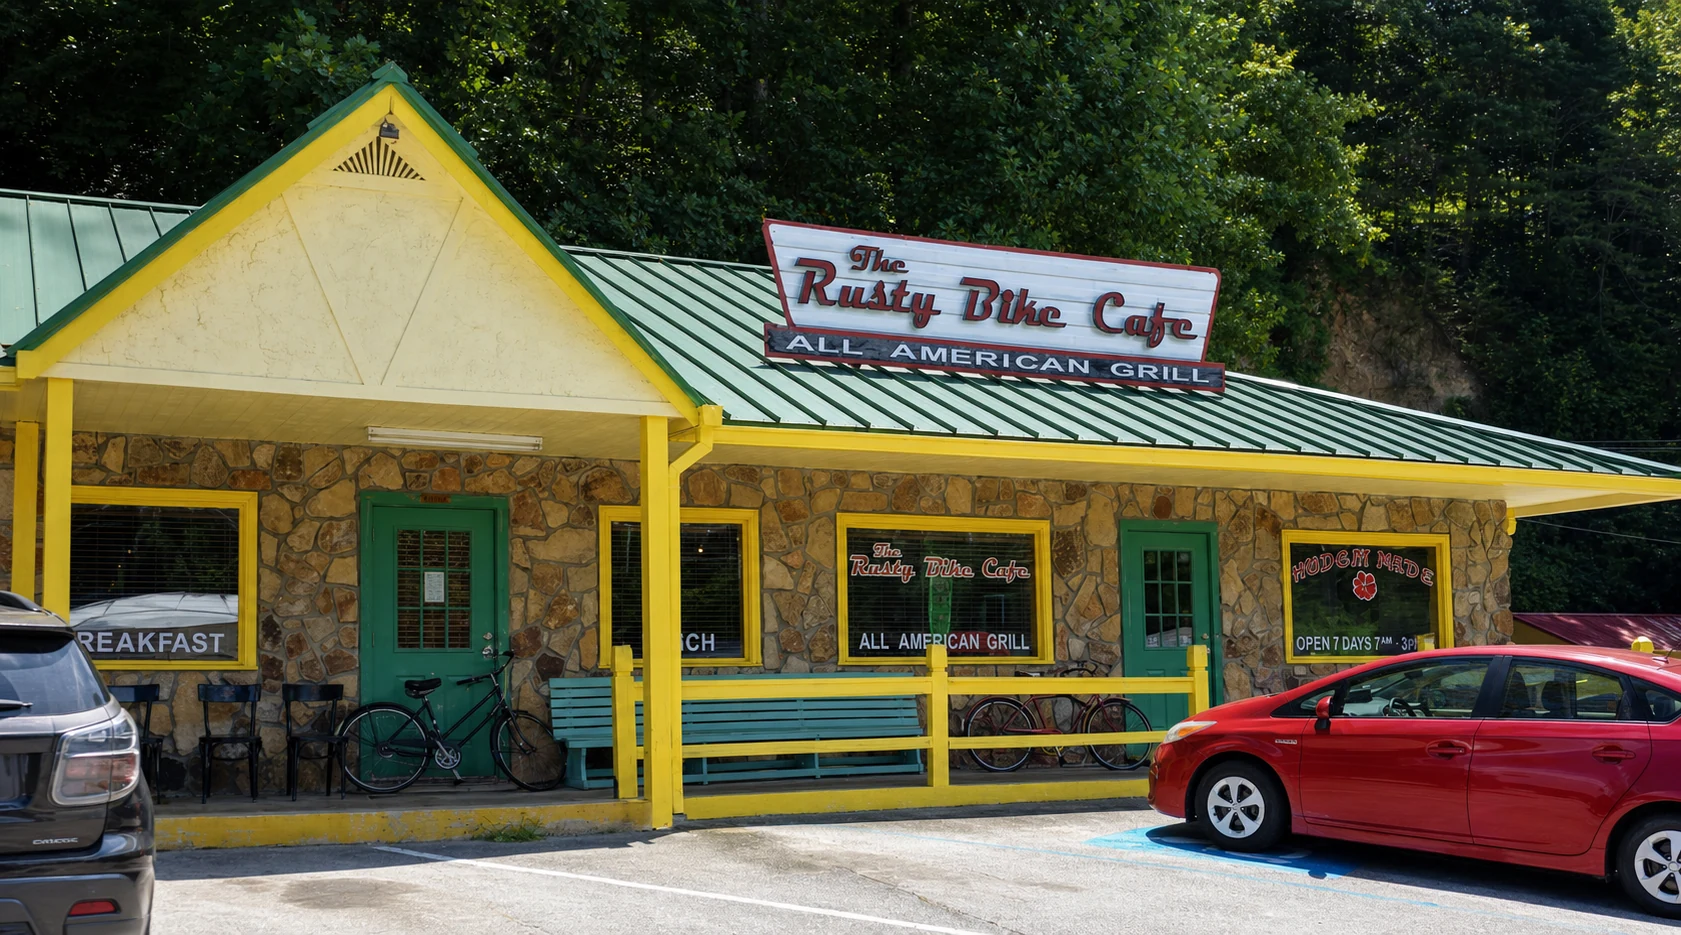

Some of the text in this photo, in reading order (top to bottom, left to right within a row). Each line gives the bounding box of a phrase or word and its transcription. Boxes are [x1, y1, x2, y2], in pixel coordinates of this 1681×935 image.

[849, 244, 908, 274] The
[795, 257, 1198, 348] Rusty Bike Cafe
[786, 334, 1209, 384] ALL AMERICAN GRILL
[873, 543, 902, 557] The
[850, 555, 1030, 583] Rusty Bike Cafe
[1376, 550, 1434, 586] MADE
[77, 632, 225, 653] REAKFAST
[859, 633, 1030, 650] ALL AMERICAN GRILL
[1296, 637, 1330, 651] OPEN
[1333, 637, 1339, 650] 7
[1342, 637, 1371, 650] DAYS
[1401, 637, 1417, 650] 3P
